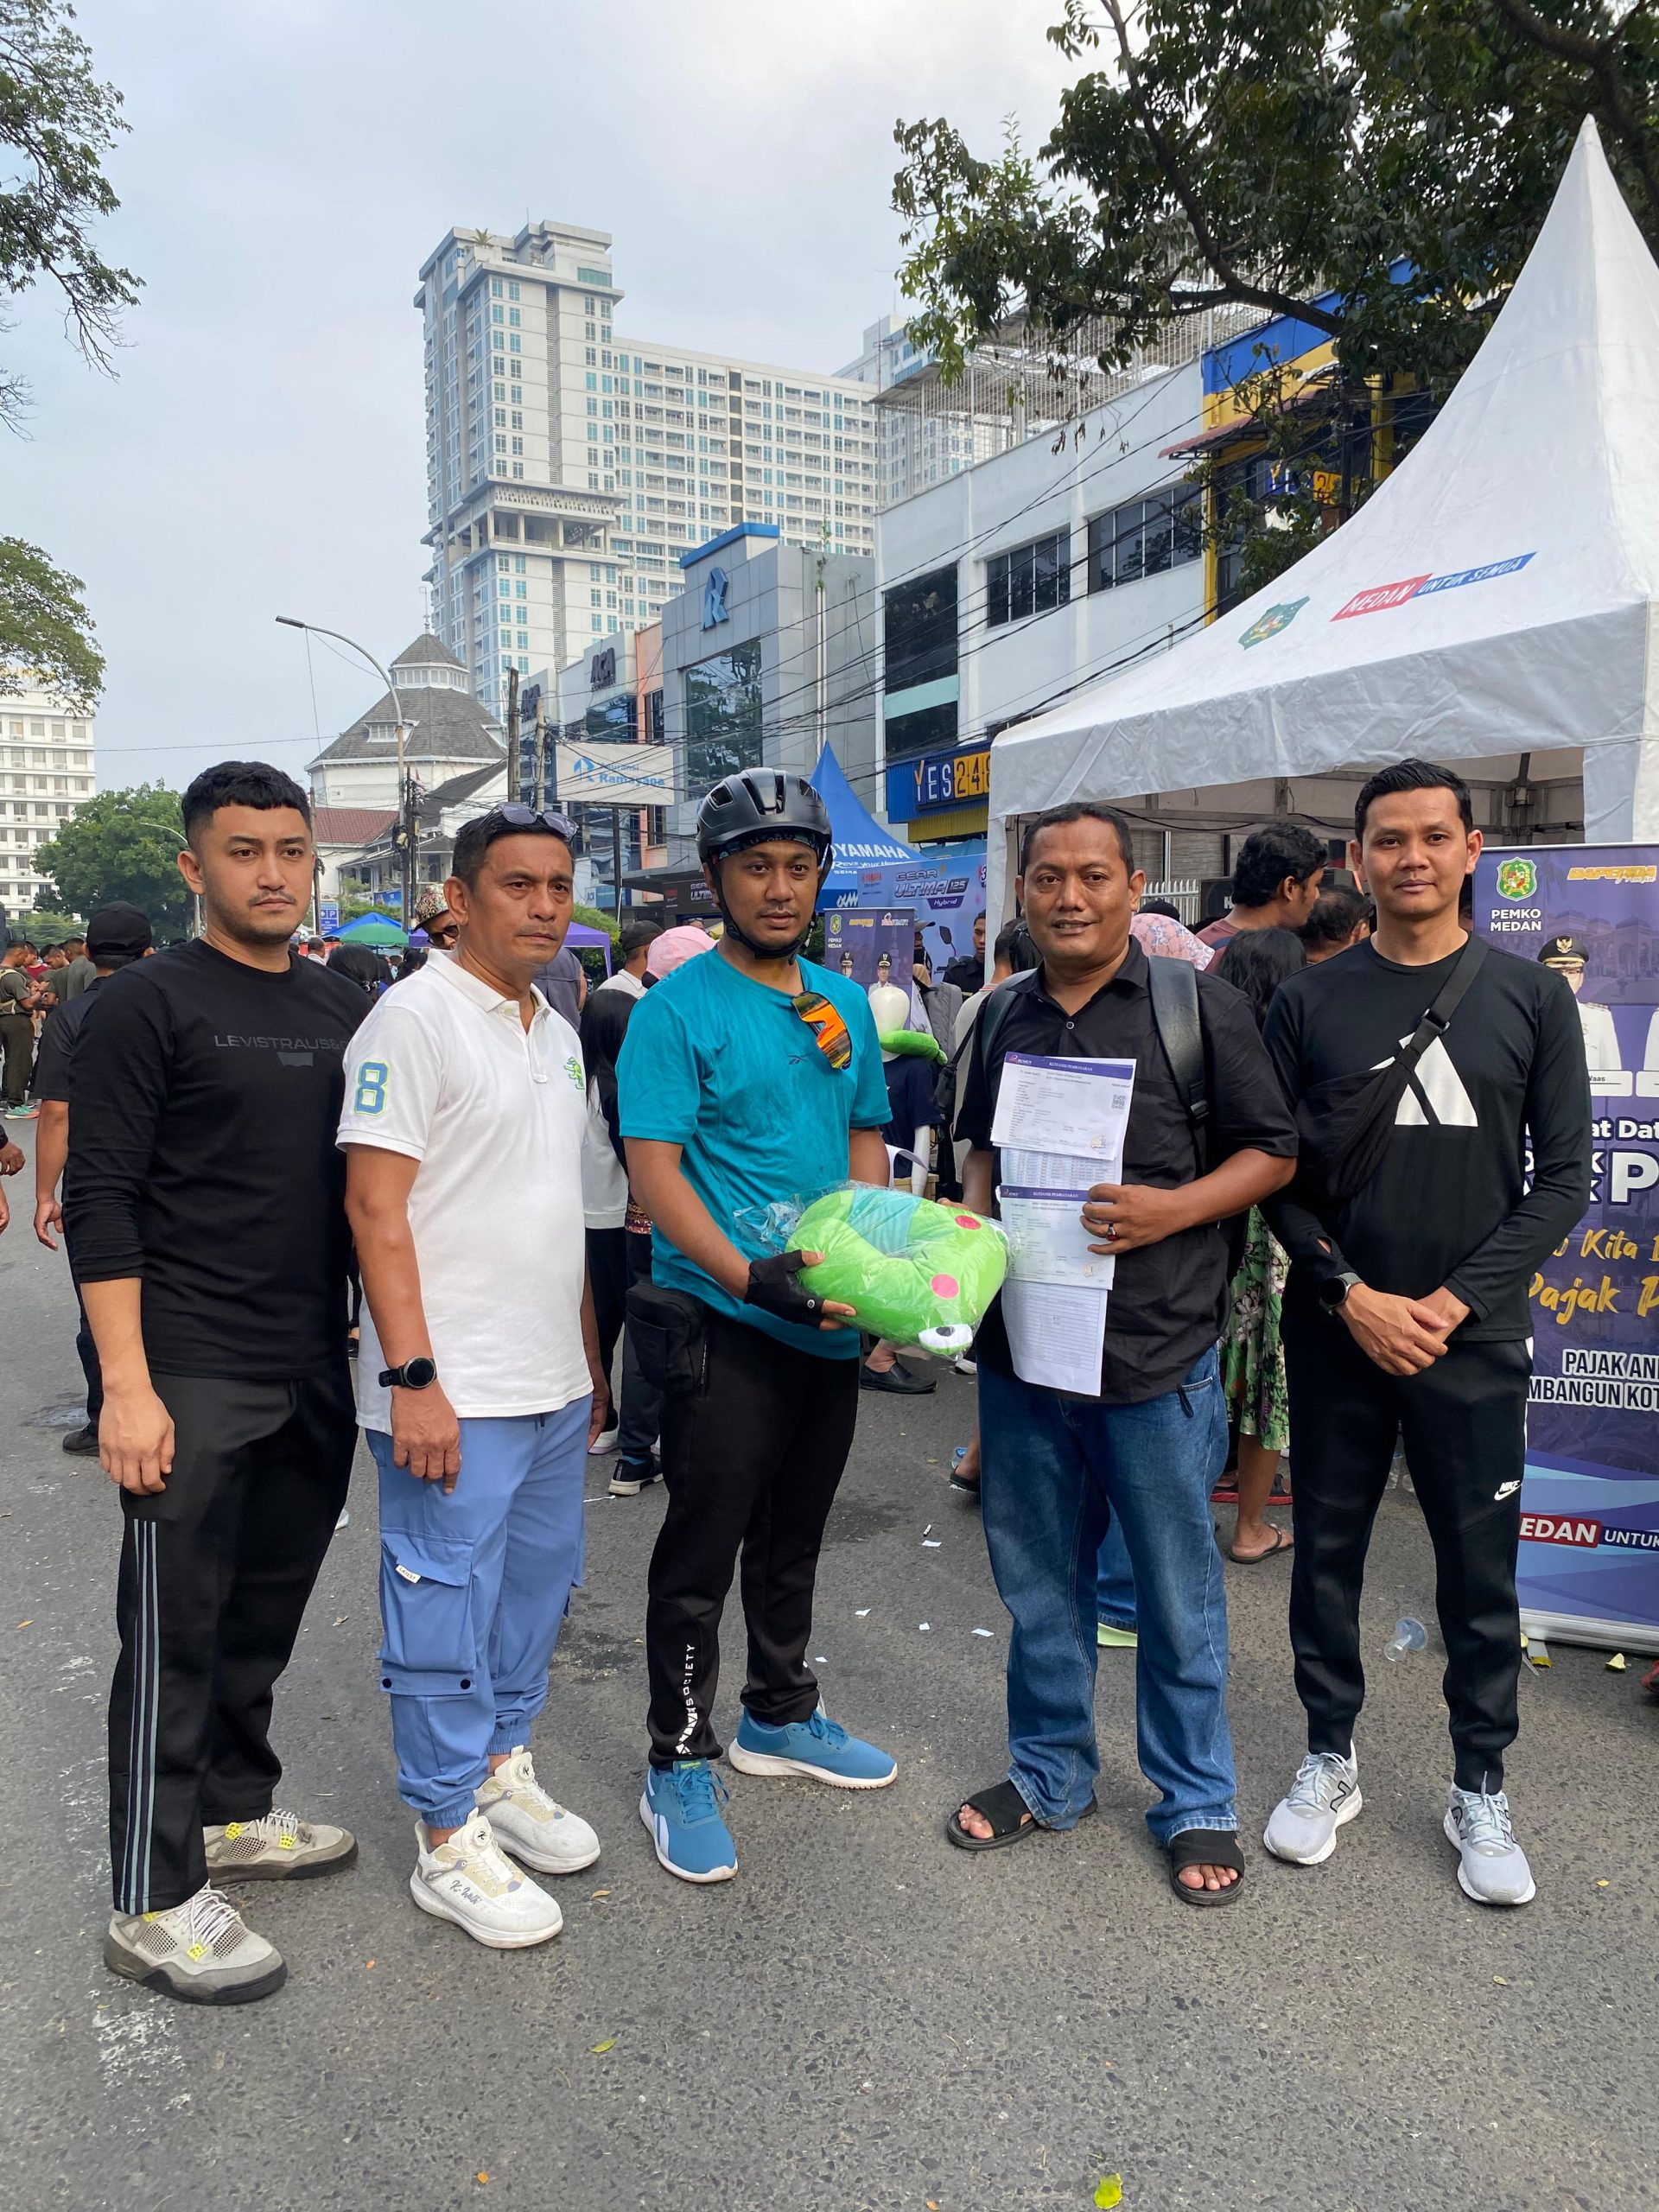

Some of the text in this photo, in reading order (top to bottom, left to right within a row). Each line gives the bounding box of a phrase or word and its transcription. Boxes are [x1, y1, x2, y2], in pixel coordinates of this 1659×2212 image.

[1342, 558, 1523, 615] MEDAN UNTUK SEMUA
[834, 843, 912, 860] YAMAHA
[895, 869, 938, 882] GEAR
[894, 880, 947, 898] ULTIMA
[950, 880, 966, 891] 125
[933, 899, 957, 907] Hybrid
[1491, 909, 1541, 919] PEMKO
[1491, 921, 1541, 931] MEDAN
[353, 1059, 389, 1116] 8
[1580, 1229, 1638, 1260] Kita
[1565, 1351, 1659, 1380] PAJAK AN
[1529, 1378, 1621, 1406] MBANGUN
[1499, 1480, 1521, 1492] NIKE
[1520, 1517, 1597, 1543] EDAN
[683, 1644, 696, 1707] SOCIETY
